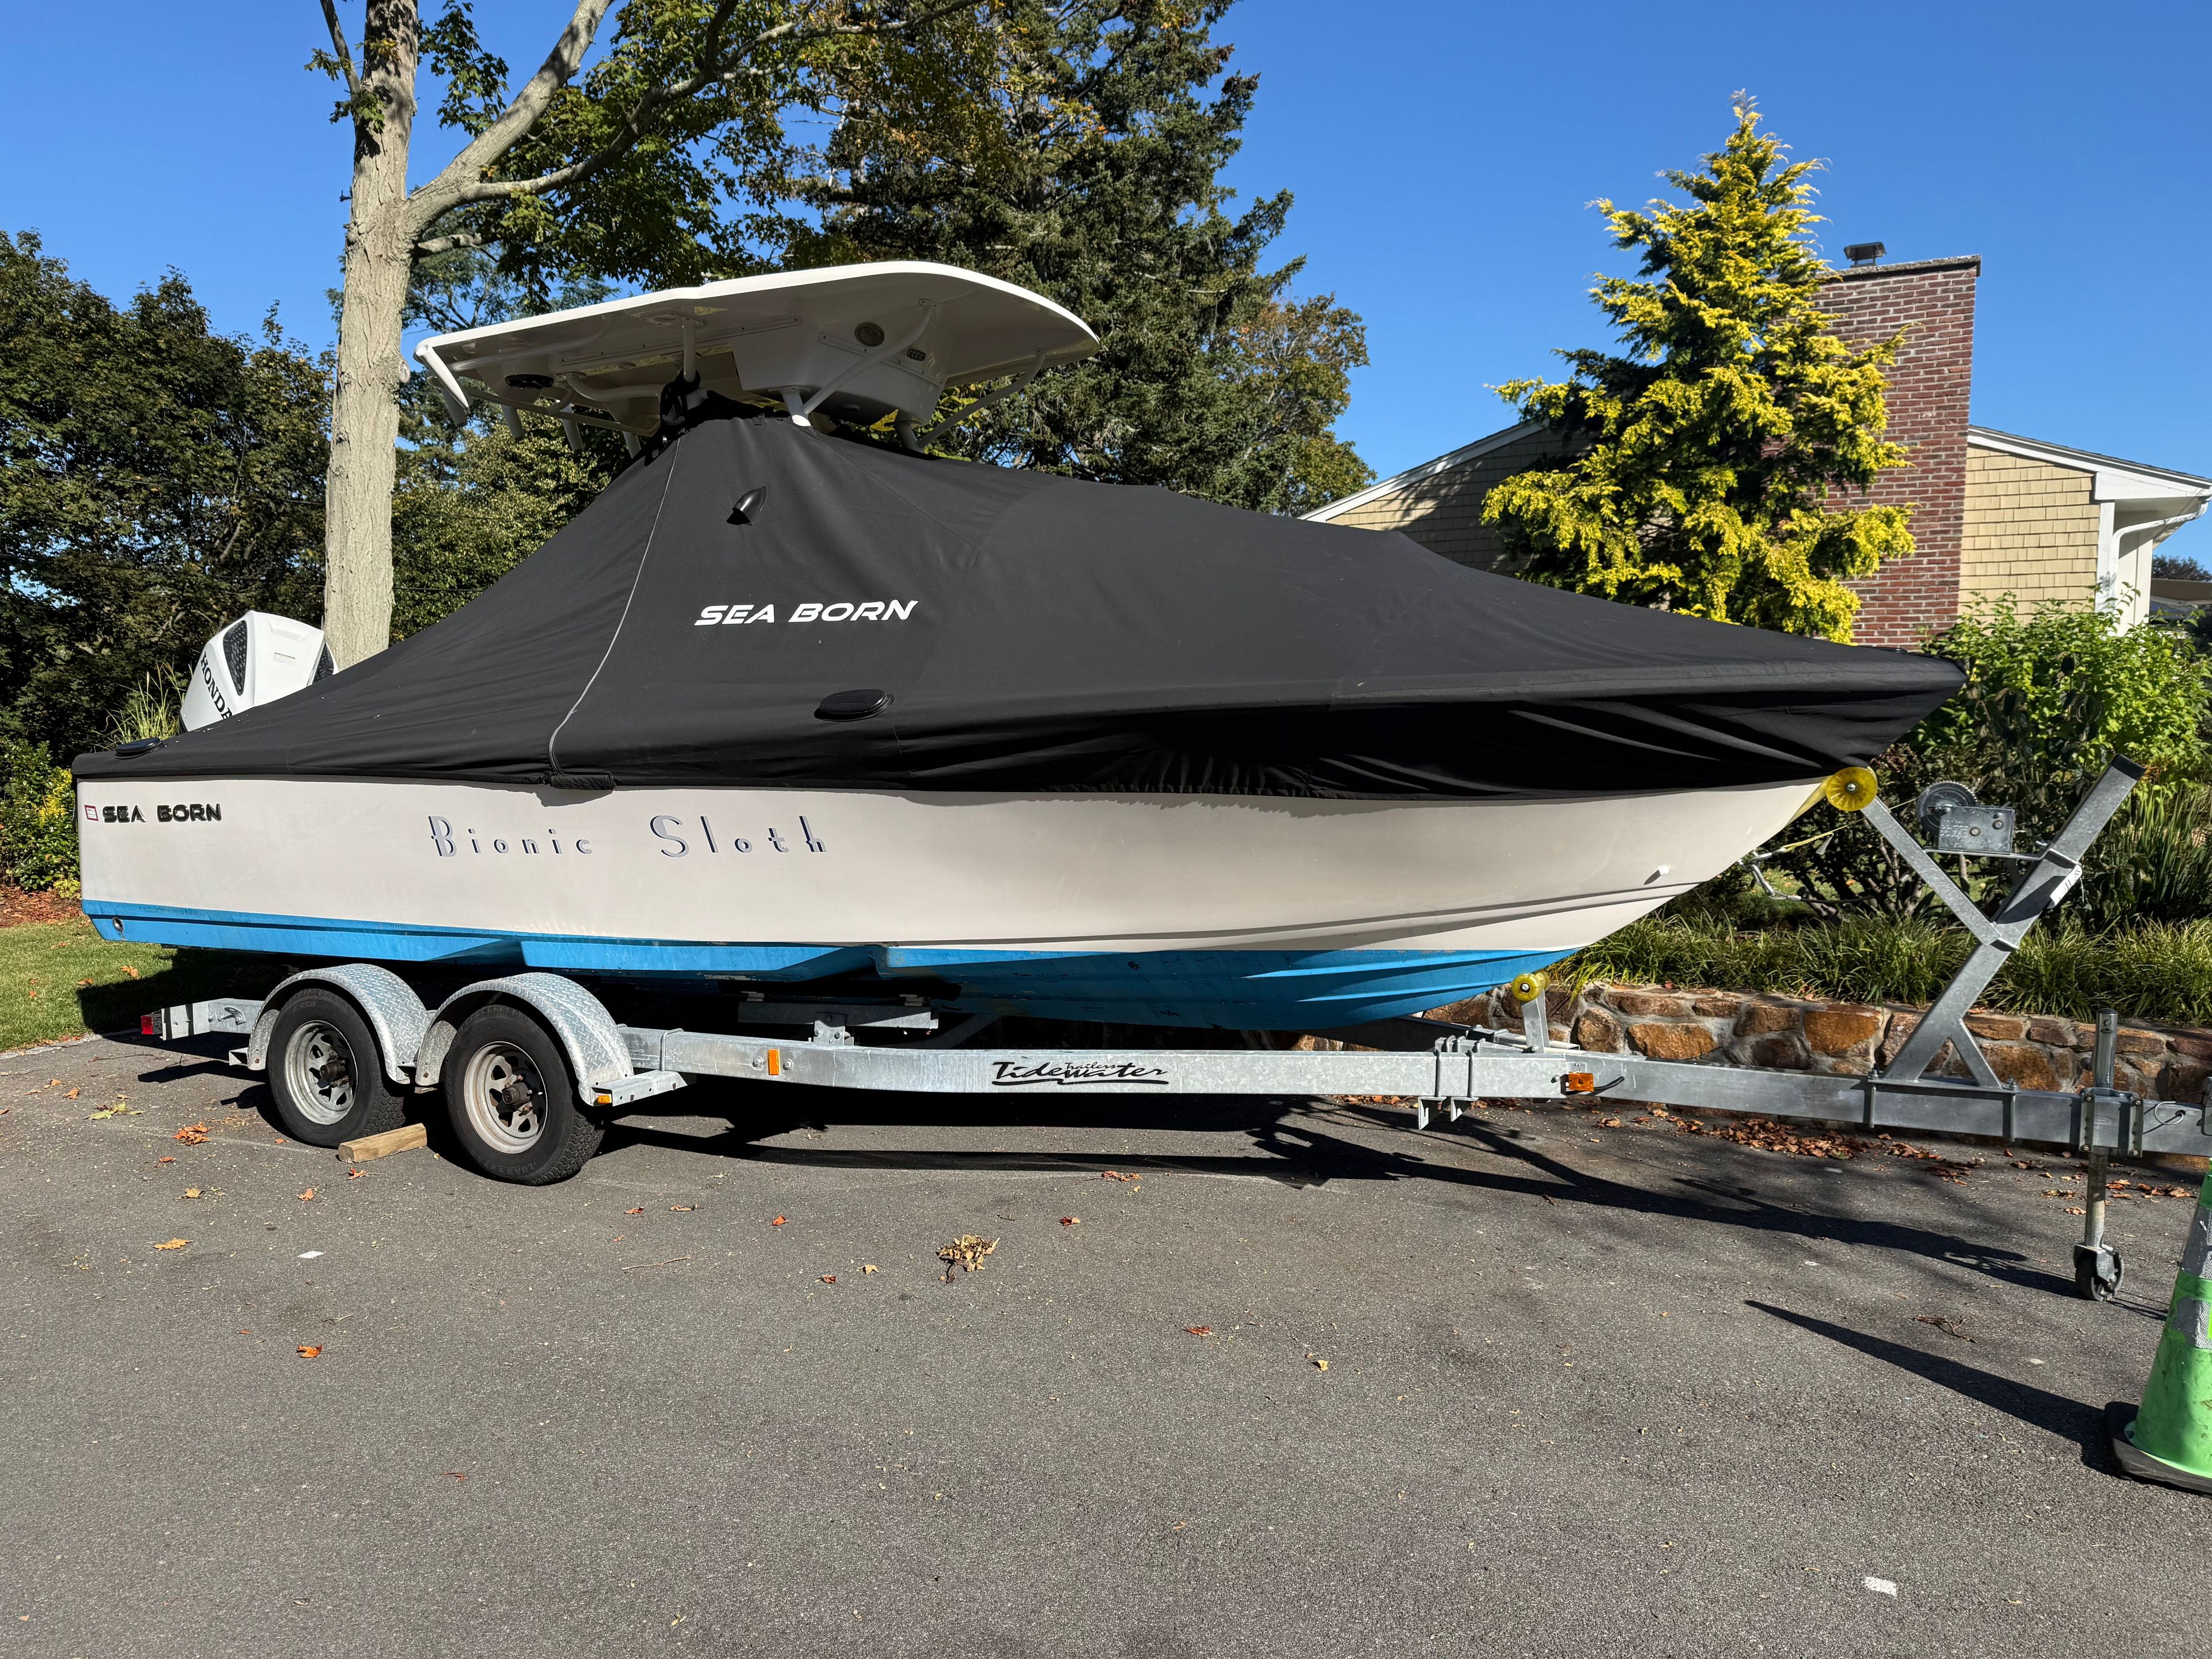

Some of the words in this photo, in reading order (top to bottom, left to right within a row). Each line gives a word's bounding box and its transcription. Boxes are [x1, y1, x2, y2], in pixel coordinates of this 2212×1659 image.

[694, 604, 775, 626] SEA
[788, 599, 919, 623] BORN
[103, 805, 147, 823] SEA
[157, 803, 222, 822] BORN
[428, 816, 593, 857] Bionic
[650, 815, 828, 858] Sloth
[991, 1062, 1169, 1080] Tidewater
[1065, 1062, 1117, 1070] Trailers
